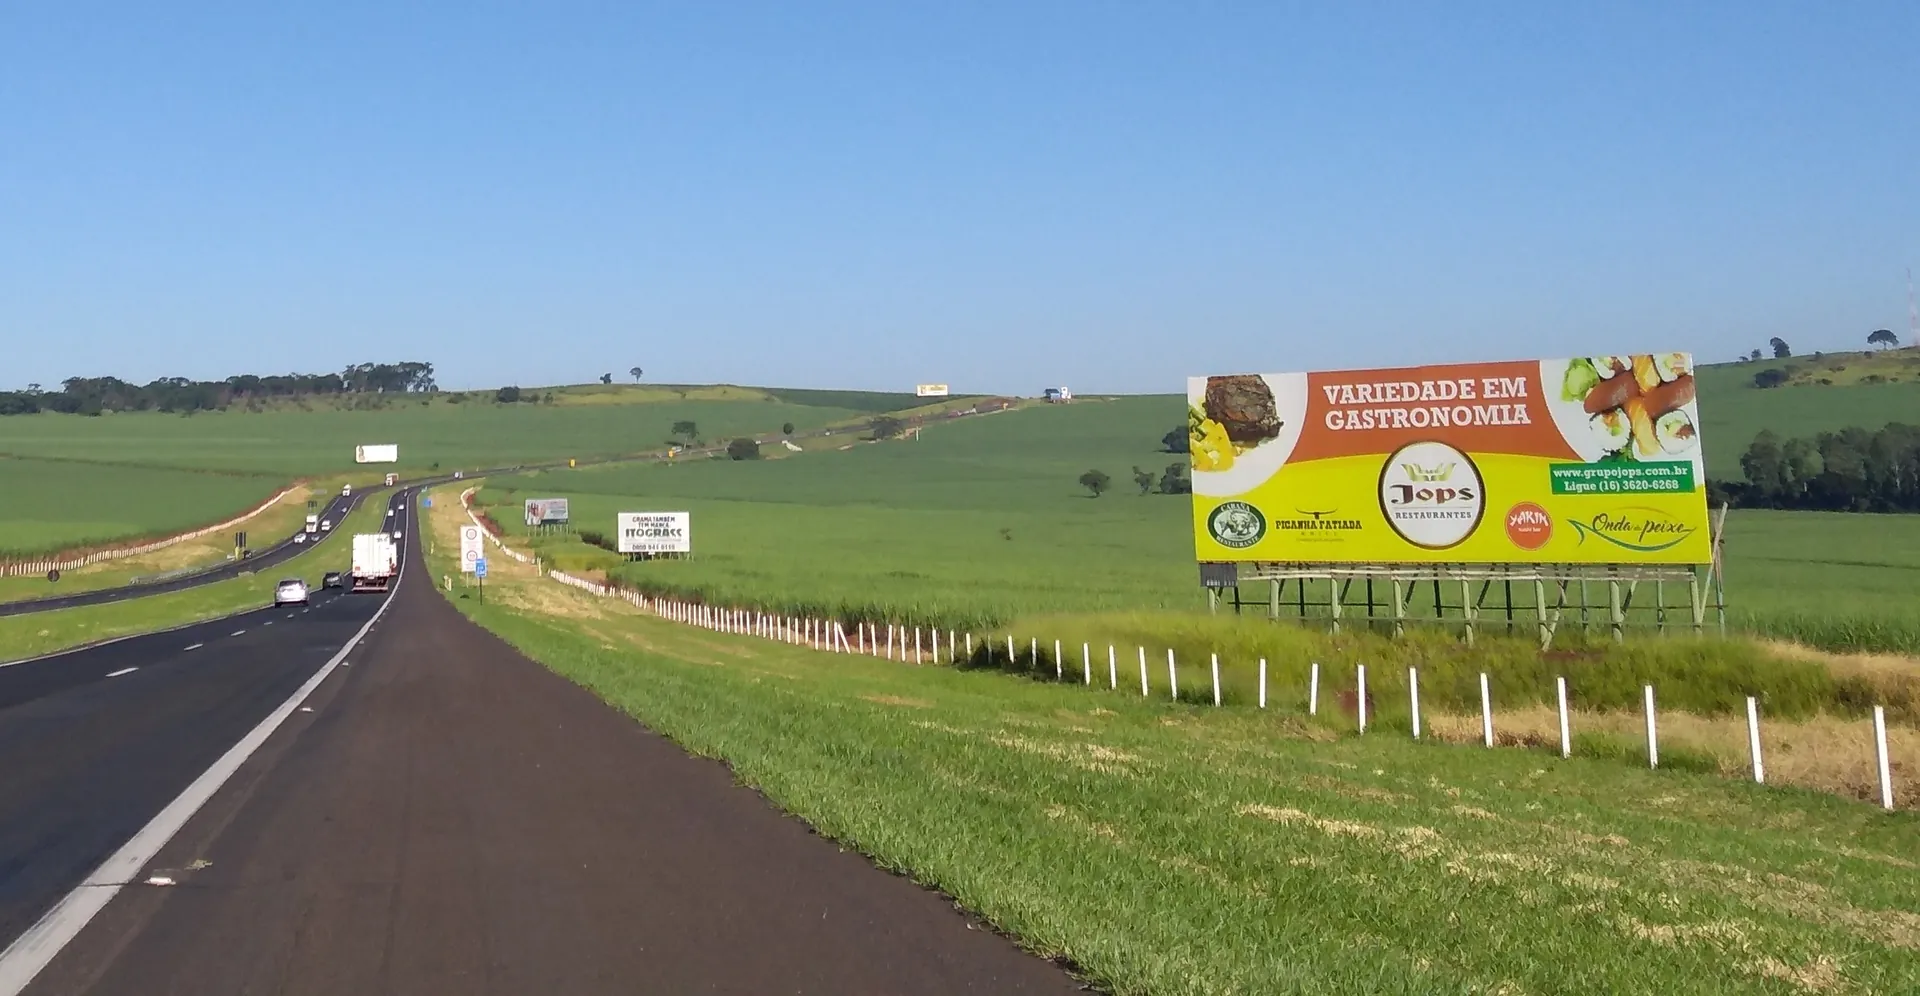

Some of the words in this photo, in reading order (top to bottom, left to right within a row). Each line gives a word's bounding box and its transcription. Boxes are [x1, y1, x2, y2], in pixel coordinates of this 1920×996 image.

[1323, 379, 1476, 405] VARIEDADE
[1482, 377, 1528, 399] EM
[1325, 404, 1532, 431] GASTRONOMIA
[1553, 465, 1688, 480] www.grupojops.com.br
[1389, 484, 1475, 505] Jops
[1564, 481, 1597, 493] Ligue
[1599, 481, 1620, 492] (16)
[1622, 480, 1680, 491] 3620-6268
[1395, 511, 1472, 520] RESTAURANTES
[1275, 520, 1318, 530] PICANHA
[1319, 520, 1363, 530] FATIADA
[1592, 513, 1632, 532] Onda
[1638, 519, 1696, 543] peixe
